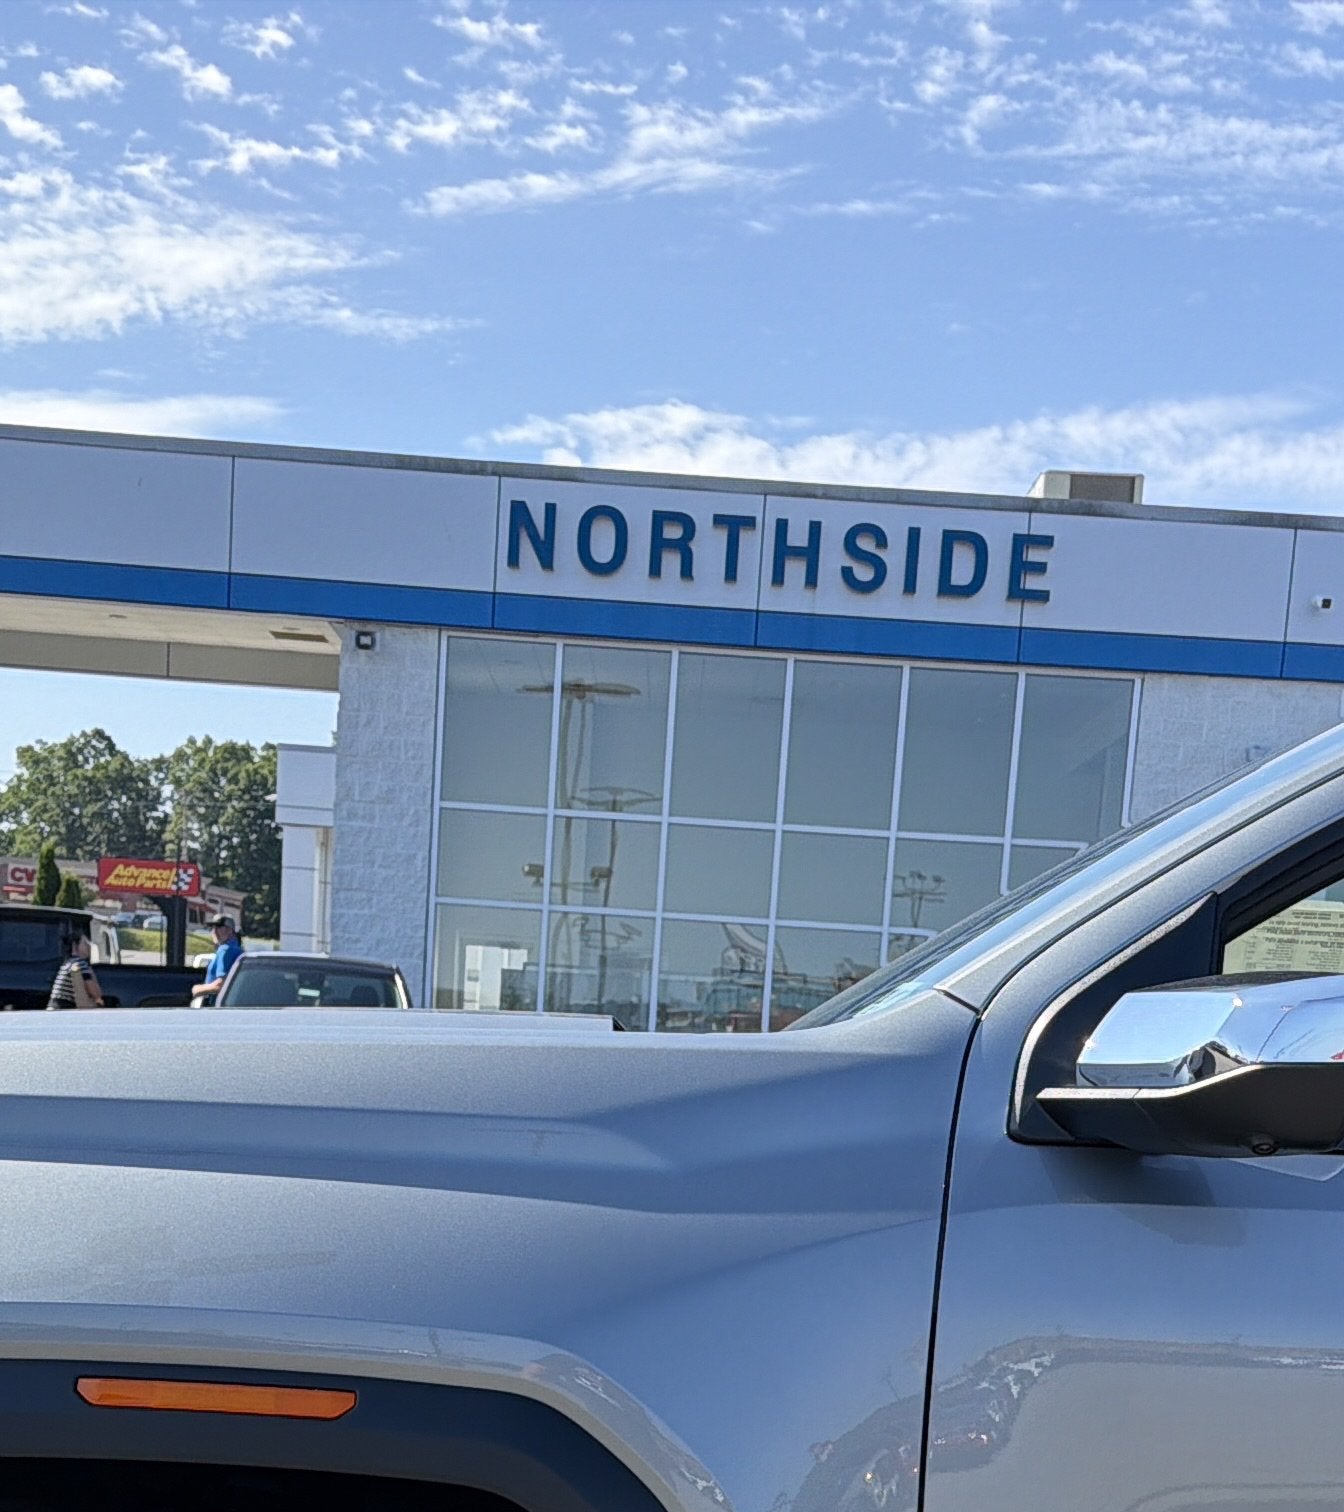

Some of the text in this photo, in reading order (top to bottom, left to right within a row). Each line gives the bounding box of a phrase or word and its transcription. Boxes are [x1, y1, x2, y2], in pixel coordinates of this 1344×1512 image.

[507, 499, 1055, 603] NORTHSIDE
[10, 866, 38, 883] CV
[113, 864, 171, 879] Advance
[104, 874, 135, 887] Auto
